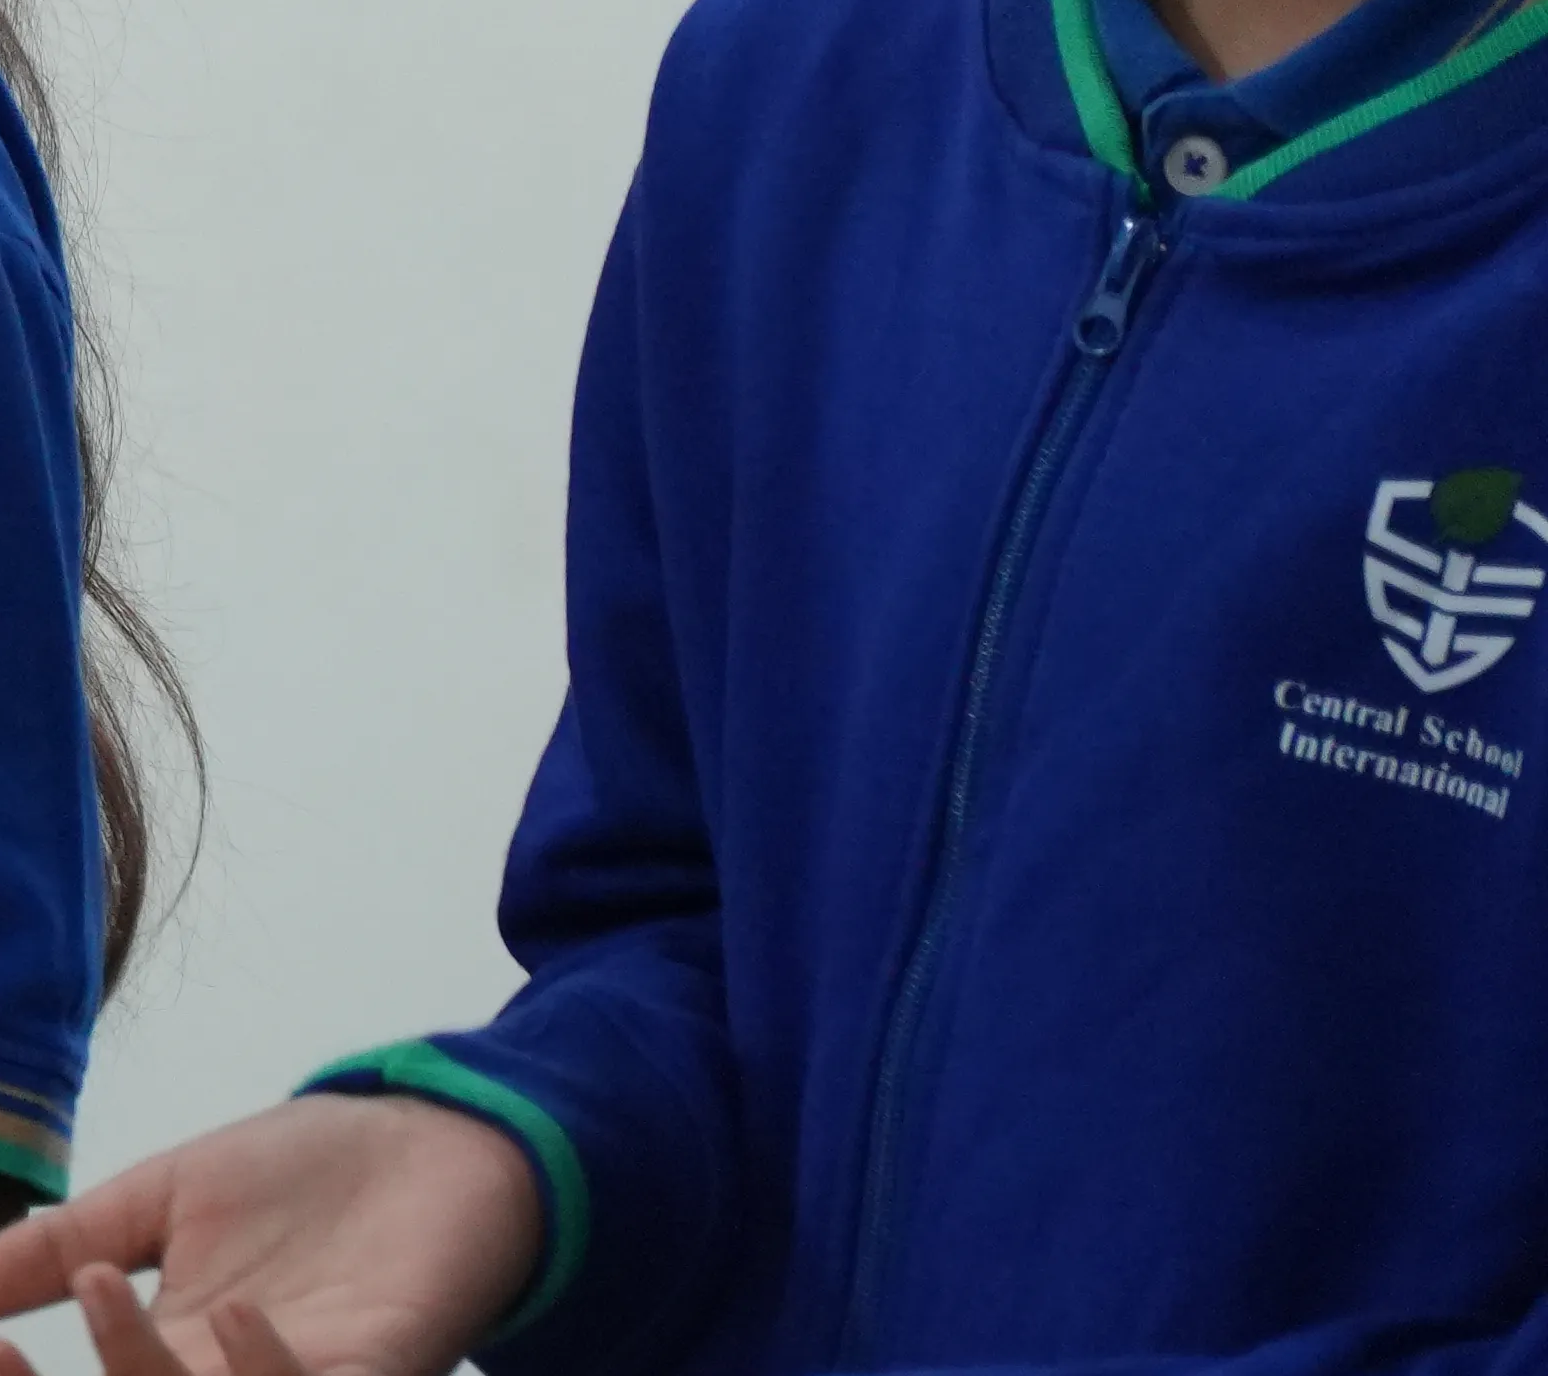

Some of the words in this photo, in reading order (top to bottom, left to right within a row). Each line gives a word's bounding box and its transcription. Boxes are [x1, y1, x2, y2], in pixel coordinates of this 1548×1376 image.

[1273, 679, 1410, 737] Central
[1419, 713, 1524, 779] School
[1278, 721, 1511, 820] International
